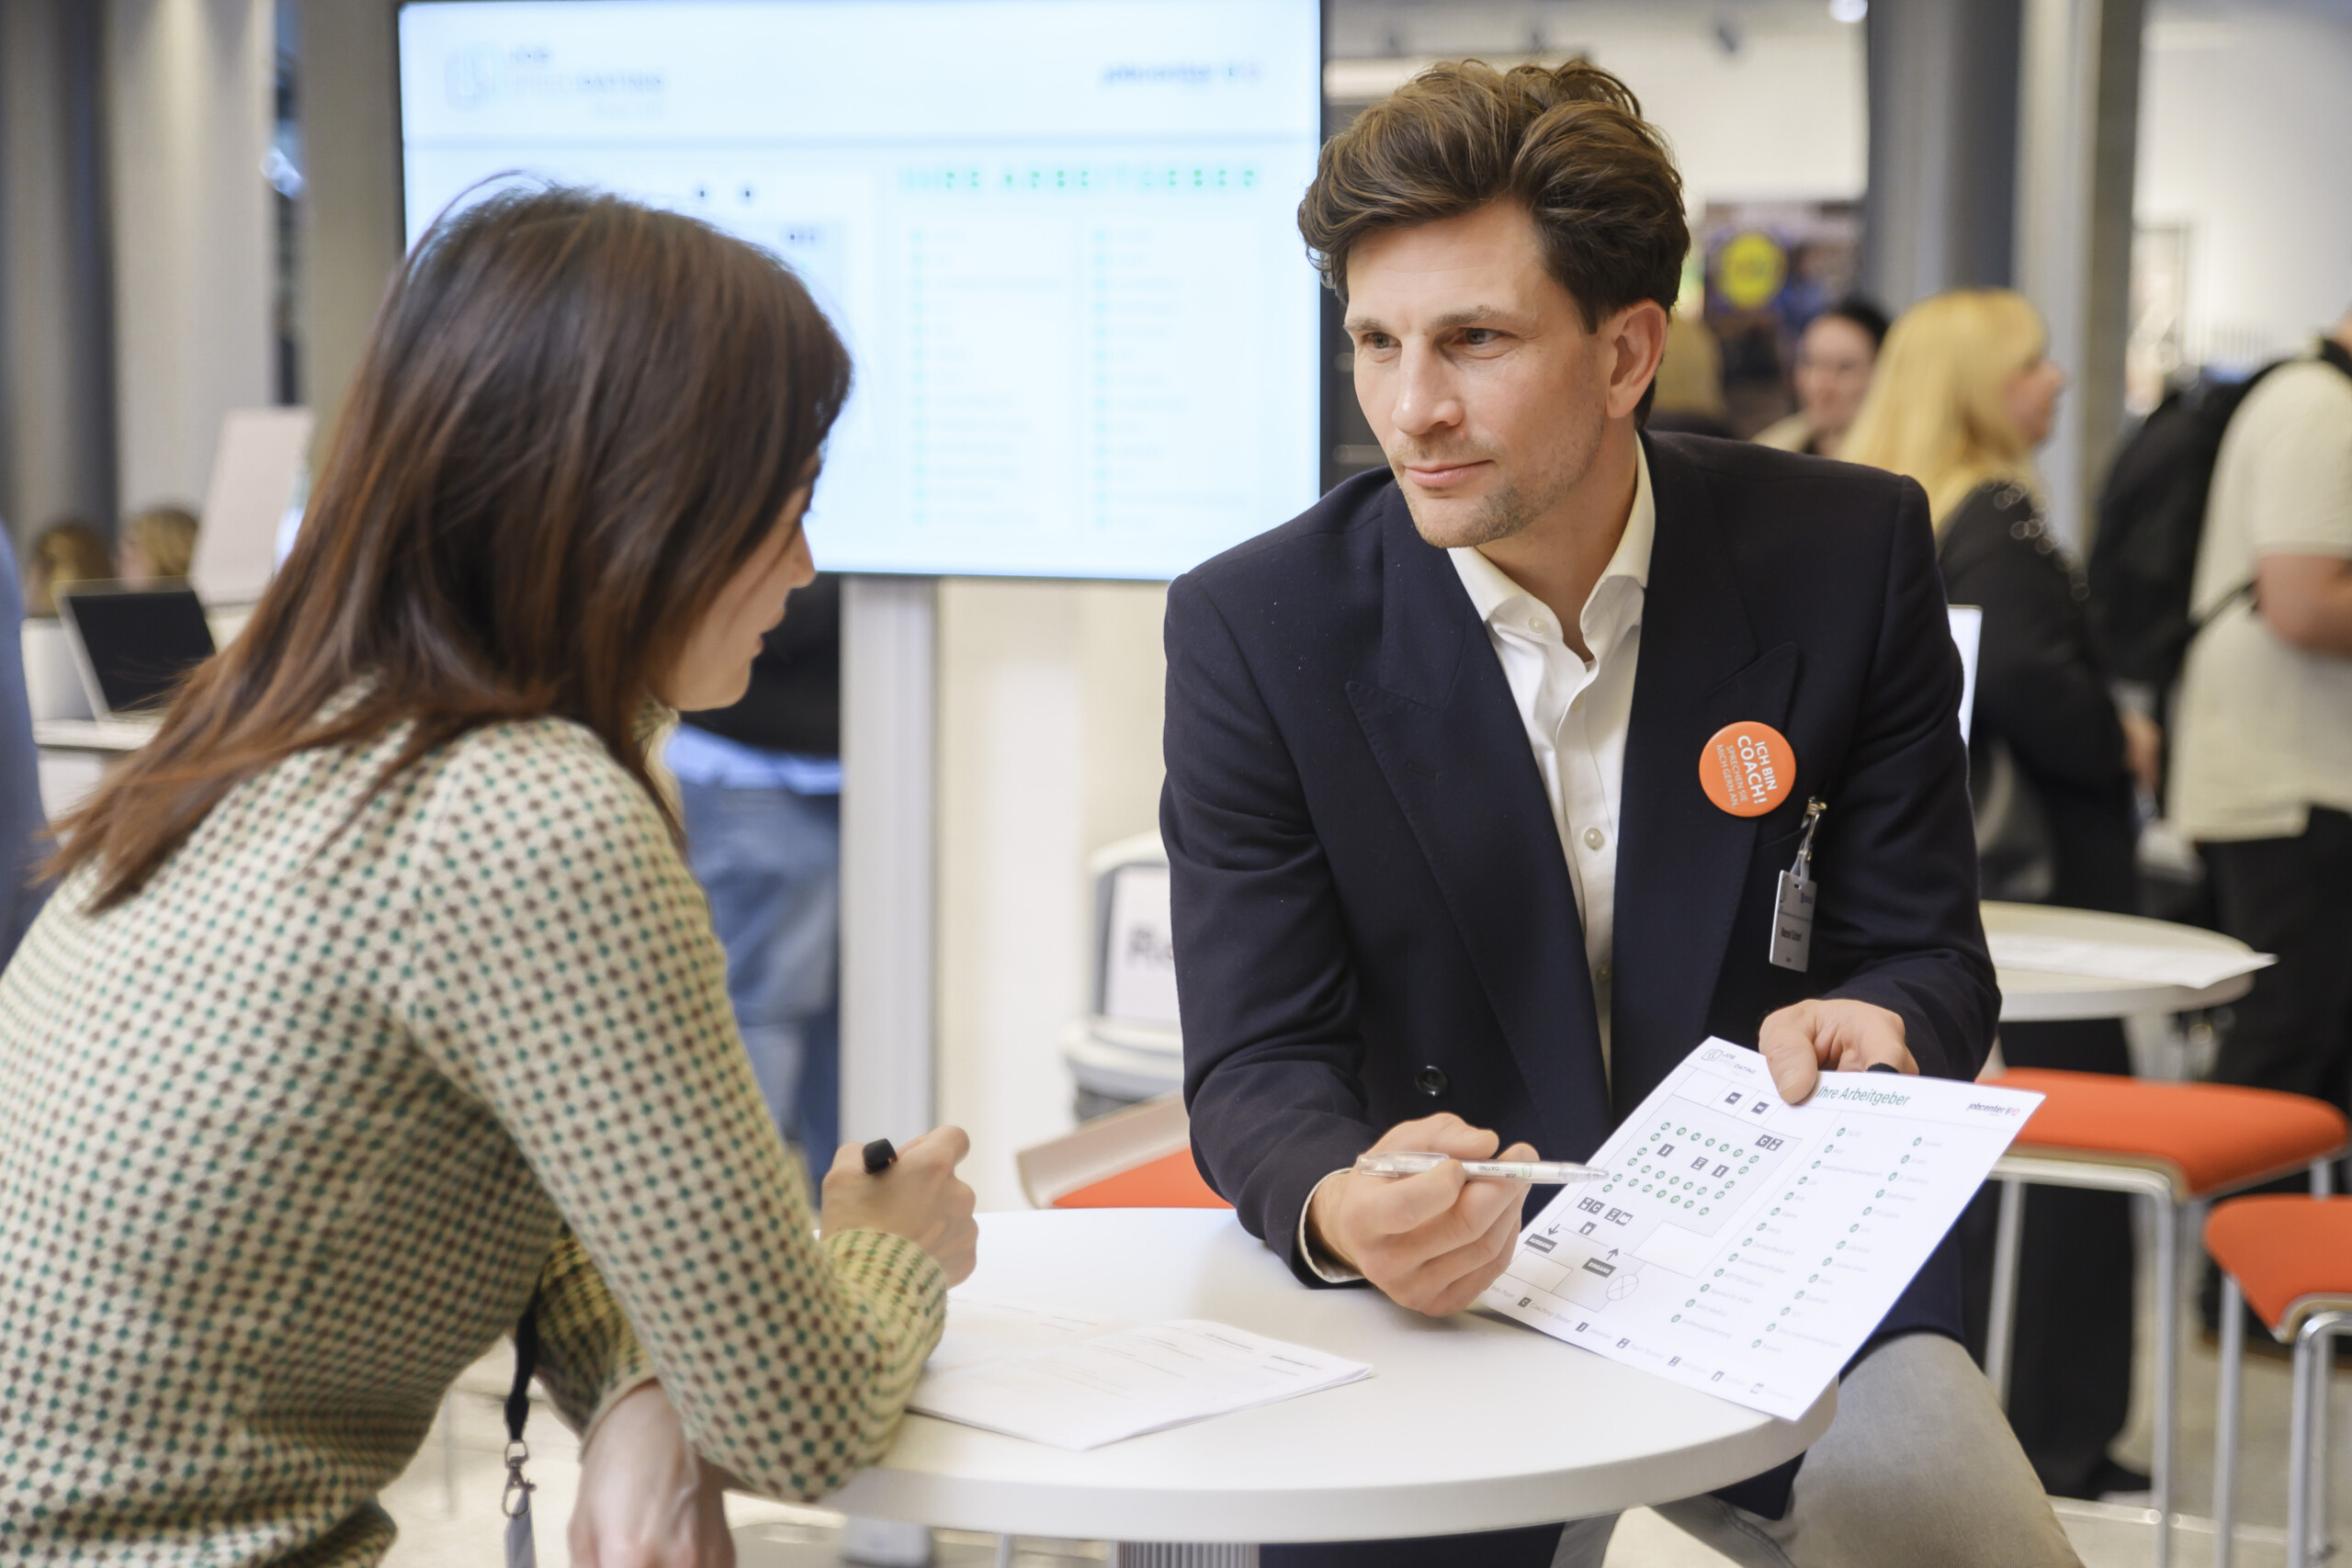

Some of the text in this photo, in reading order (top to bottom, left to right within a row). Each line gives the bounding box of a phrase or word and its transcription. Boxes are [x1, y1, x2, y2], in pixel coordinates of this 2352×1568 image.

[1715, 744, 1728, 768] MICH
[1722, 769, 1736, 793] GERN
[1725, 745, 1748, 802] SPRECHEN SIE
[1737, 735, 1768, 805] COACH!
[1755, 741, 1778, 791] ICH BIN
[1815, 1086, 1910, 1108] Ihre Arbeitgeber
[1966, 1102, 2006, 1114] jobcenter
[1528, 1236, 1553, 1250] AUSGANG
[1588, 1261, 1611, 1274] EINGANG
